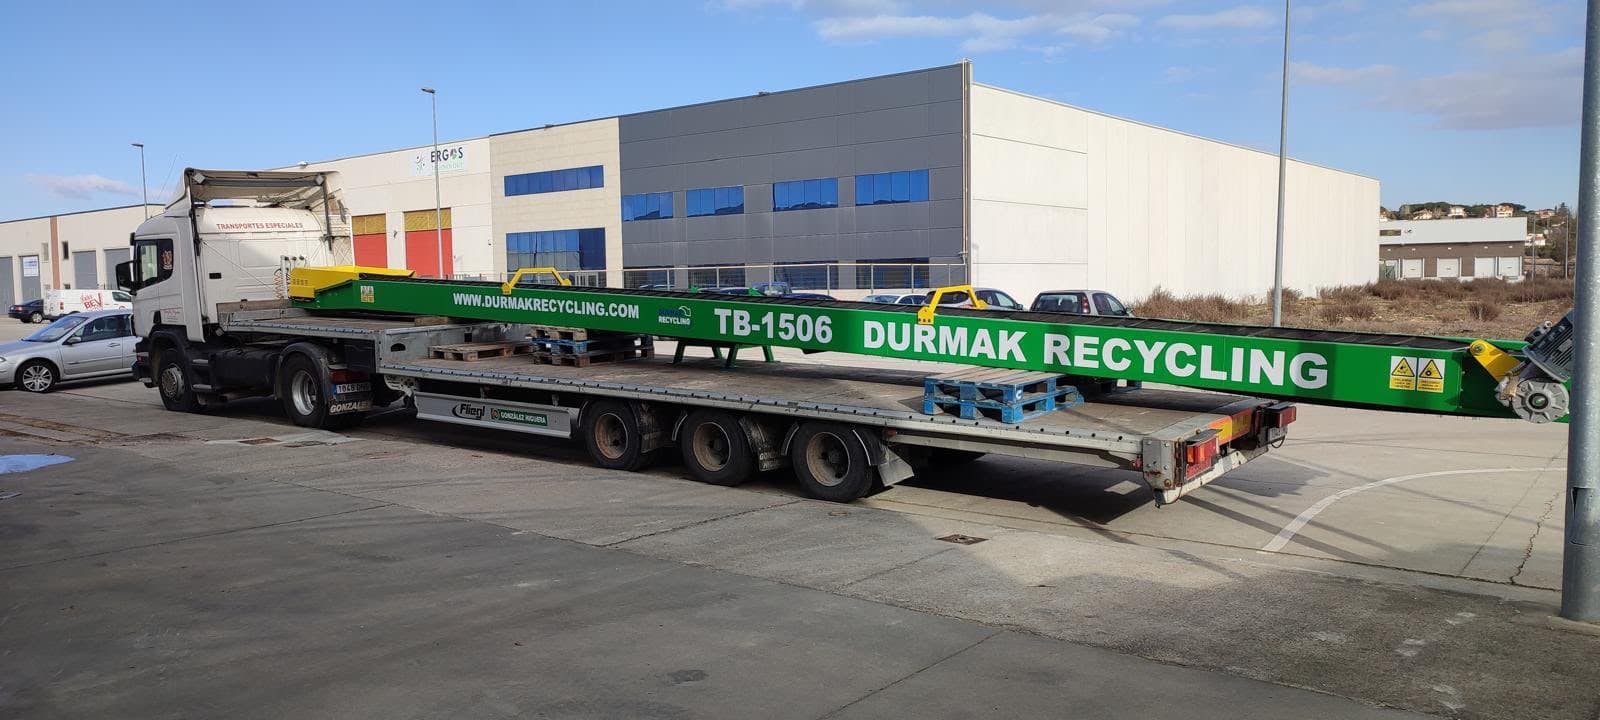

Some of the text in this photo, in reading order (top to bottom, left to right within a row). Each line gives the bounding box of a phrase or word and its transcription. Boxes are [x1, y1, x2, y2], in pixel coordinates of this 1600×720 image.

[431, 147, 463, 163] ERGOS
[216, 222, 264, 230] TRANSPORTES
[453, 293, 640, 319] WWW.DURMAKRECYCLING.COM
[658, 315, 690, 325] RECYCLING
[714, 308, 833, 344] TB-1506
[863, 320, 1328, 389] DURMAK RECYCLING
[460, 403, 485, 419] Fliegl
[525, 414, 546, 423] HIGUERA
